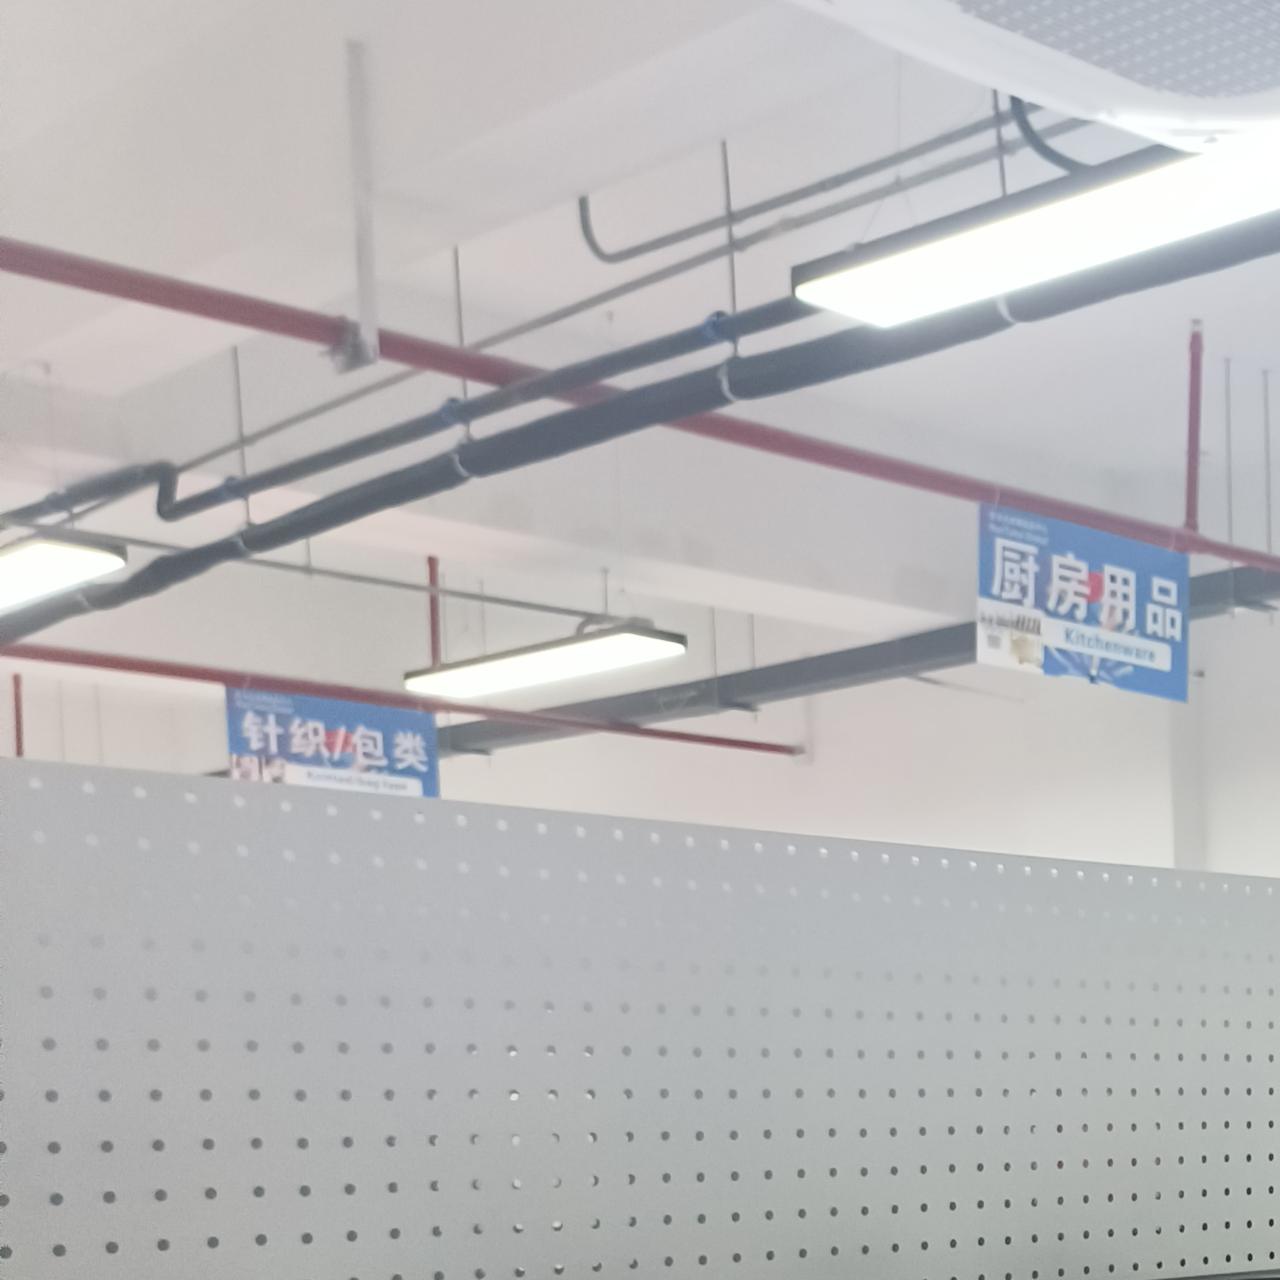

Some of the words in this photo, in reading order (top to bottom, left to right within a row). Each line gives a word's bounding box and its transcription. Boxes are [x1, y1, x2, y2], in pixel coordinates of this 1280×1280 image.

[991, 537, 1182, 642] 厨房用品
[1063, 627, 1157, 663] Kitchenware
